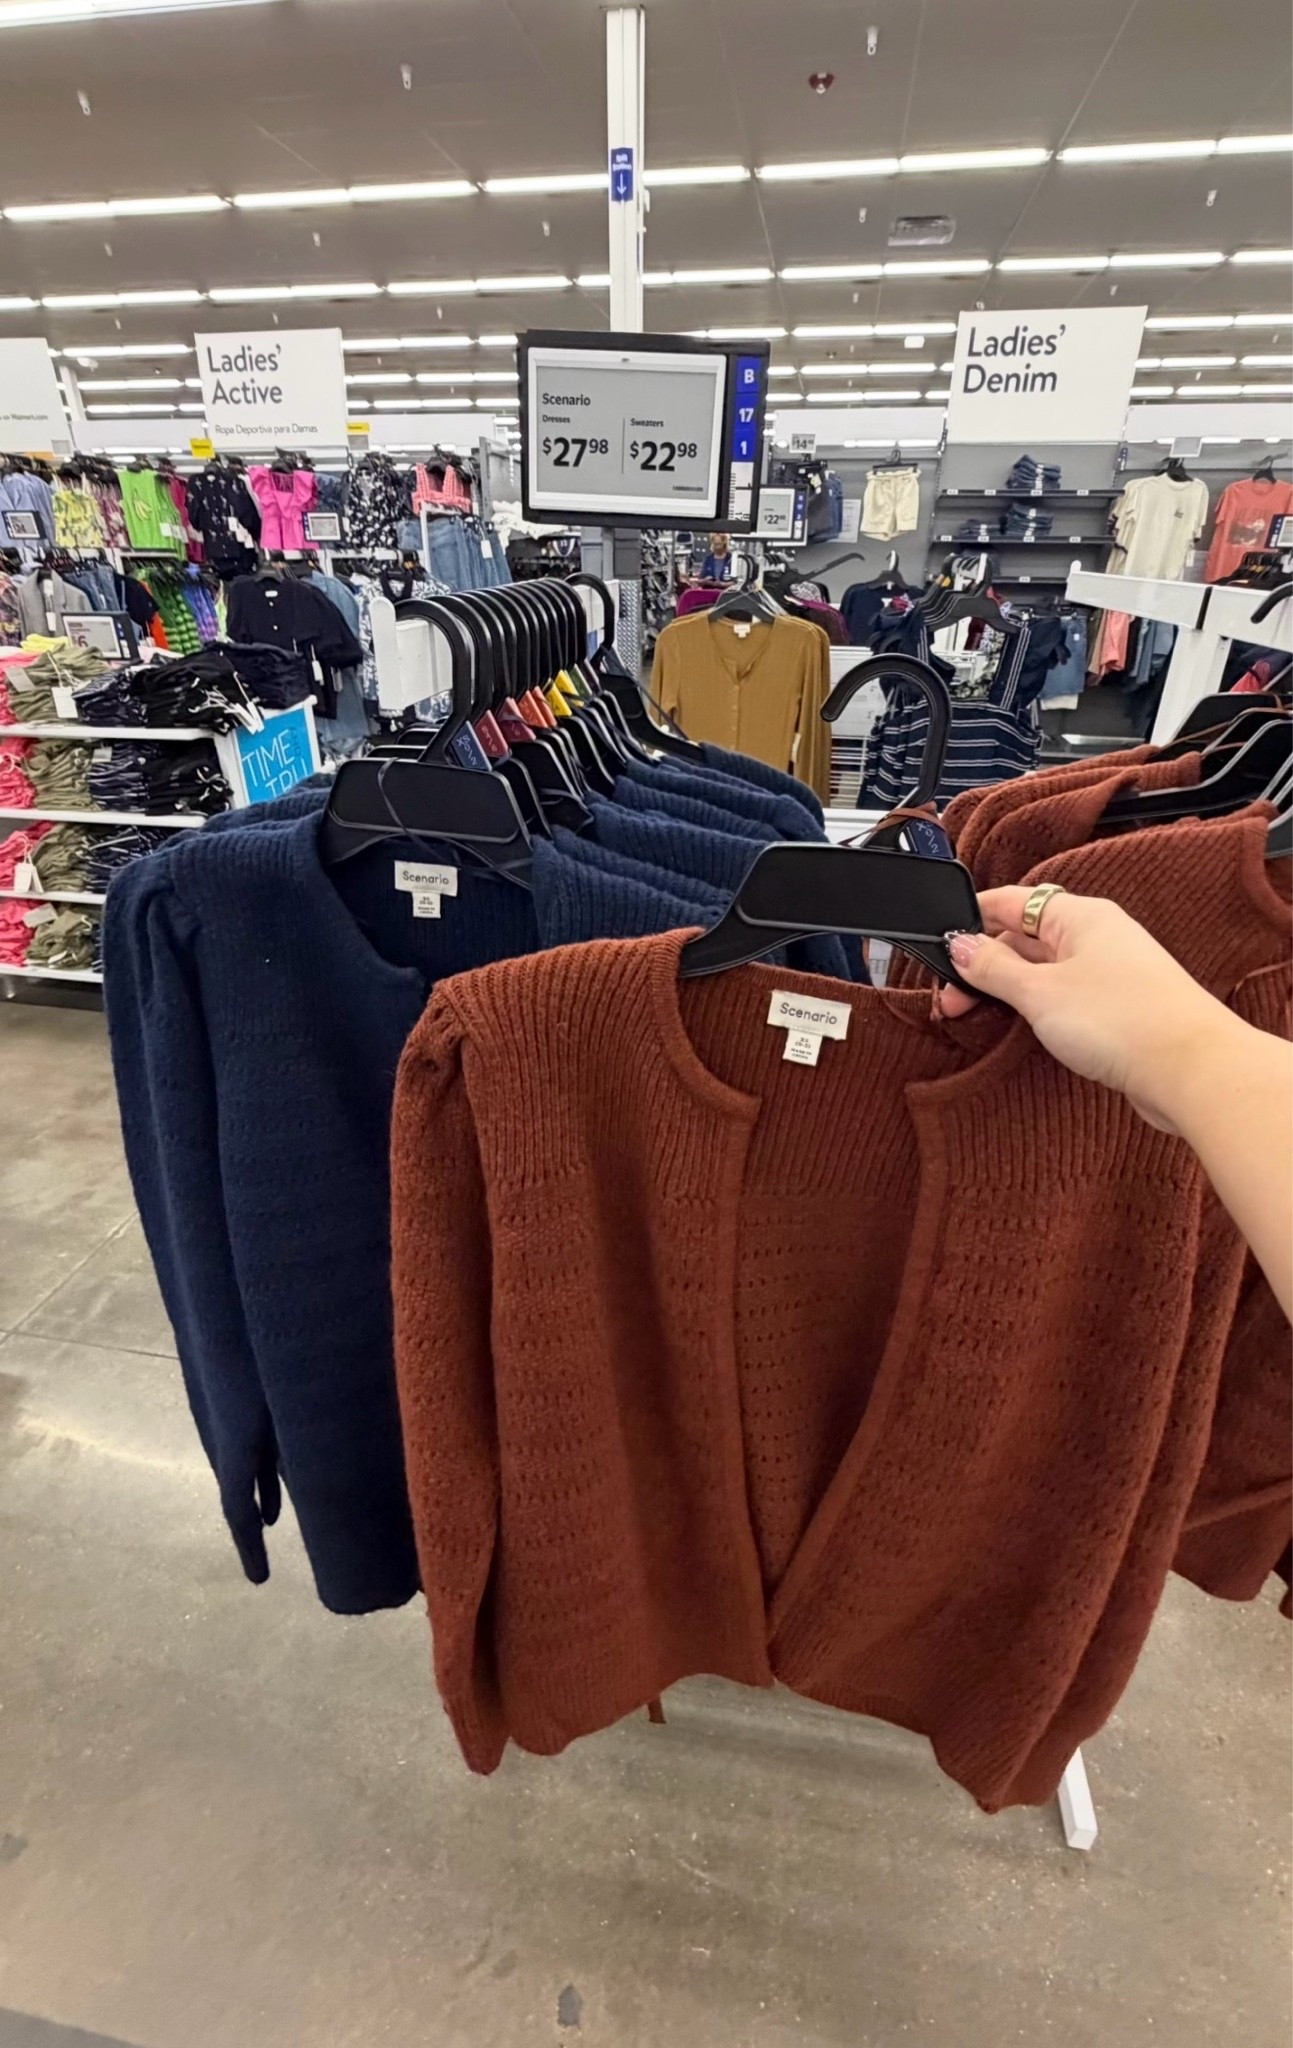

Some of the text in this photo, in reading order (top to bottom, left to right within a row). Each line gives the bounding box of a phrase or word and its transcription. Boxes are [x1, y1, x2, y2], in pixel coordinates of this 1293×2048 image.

[967, 323, 1066, 357] Ladies'
[207, 343, 282, 373] Ladies'
[743, 368, 755, 384] B
[963, 363, 1058, 394] Denim
[212, 378, 283, 405] Active
[541, 392, 591, 406] Scenario
[542, 414, 571, 424] Dresses
[630, 418, 664, 428] Sweaters
[738, 408, 754, 423] 17
[215, 423, 318, 436] Ropa Deportiva para Damas
[740, 441, 748, 456] 1
[241, 728, 295, 787] TIME
[402, 870, 450, 885] Scenario
[779, 1002, 838, 1025] Scenario
